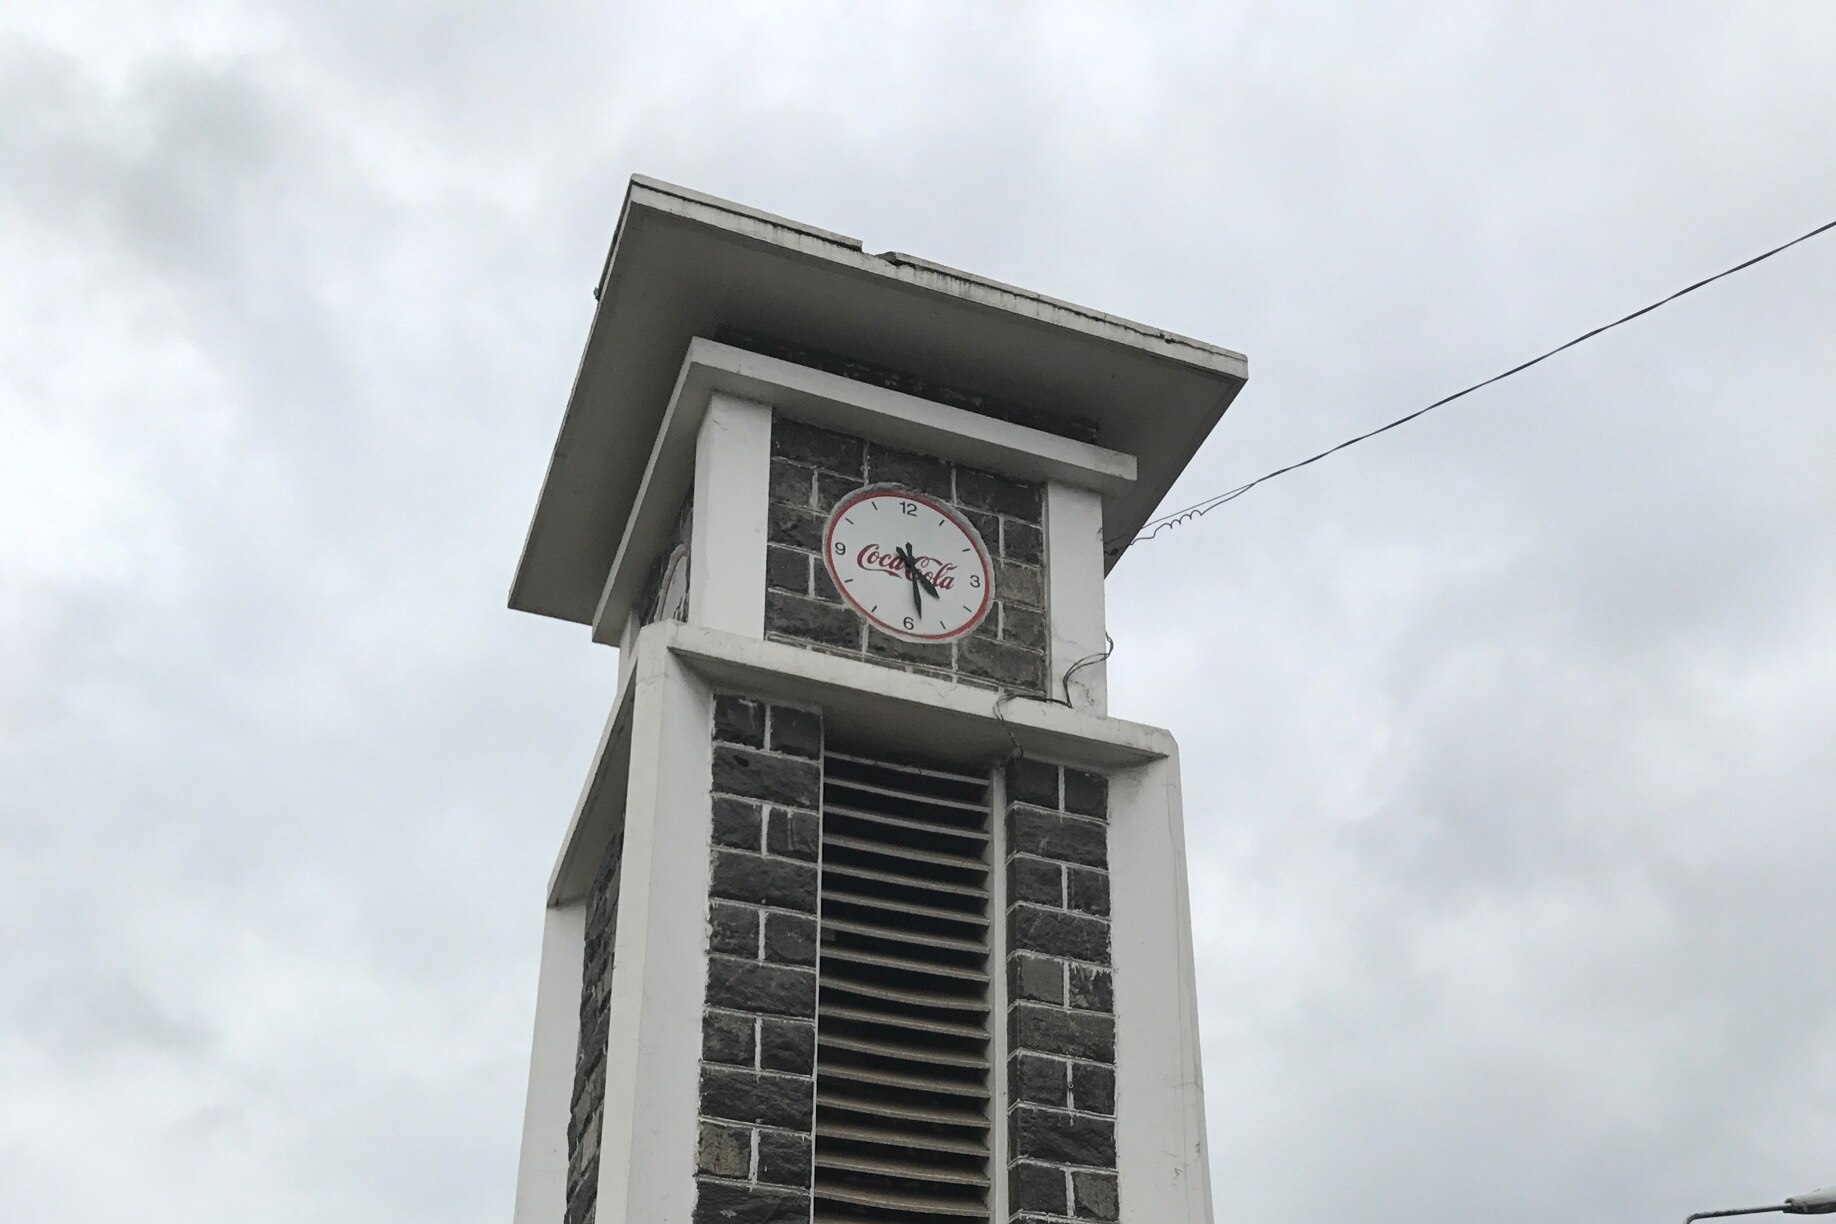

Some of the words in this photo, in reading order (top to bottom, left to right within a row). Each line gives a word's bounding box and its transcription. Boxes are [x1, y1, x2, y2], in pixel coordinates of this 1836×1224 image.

[900, 501, 918, 517] 12
[834, 542, 846, 556] 9
[969, 575, 981, 588] 3
[903, 616, 914, 631] 6
